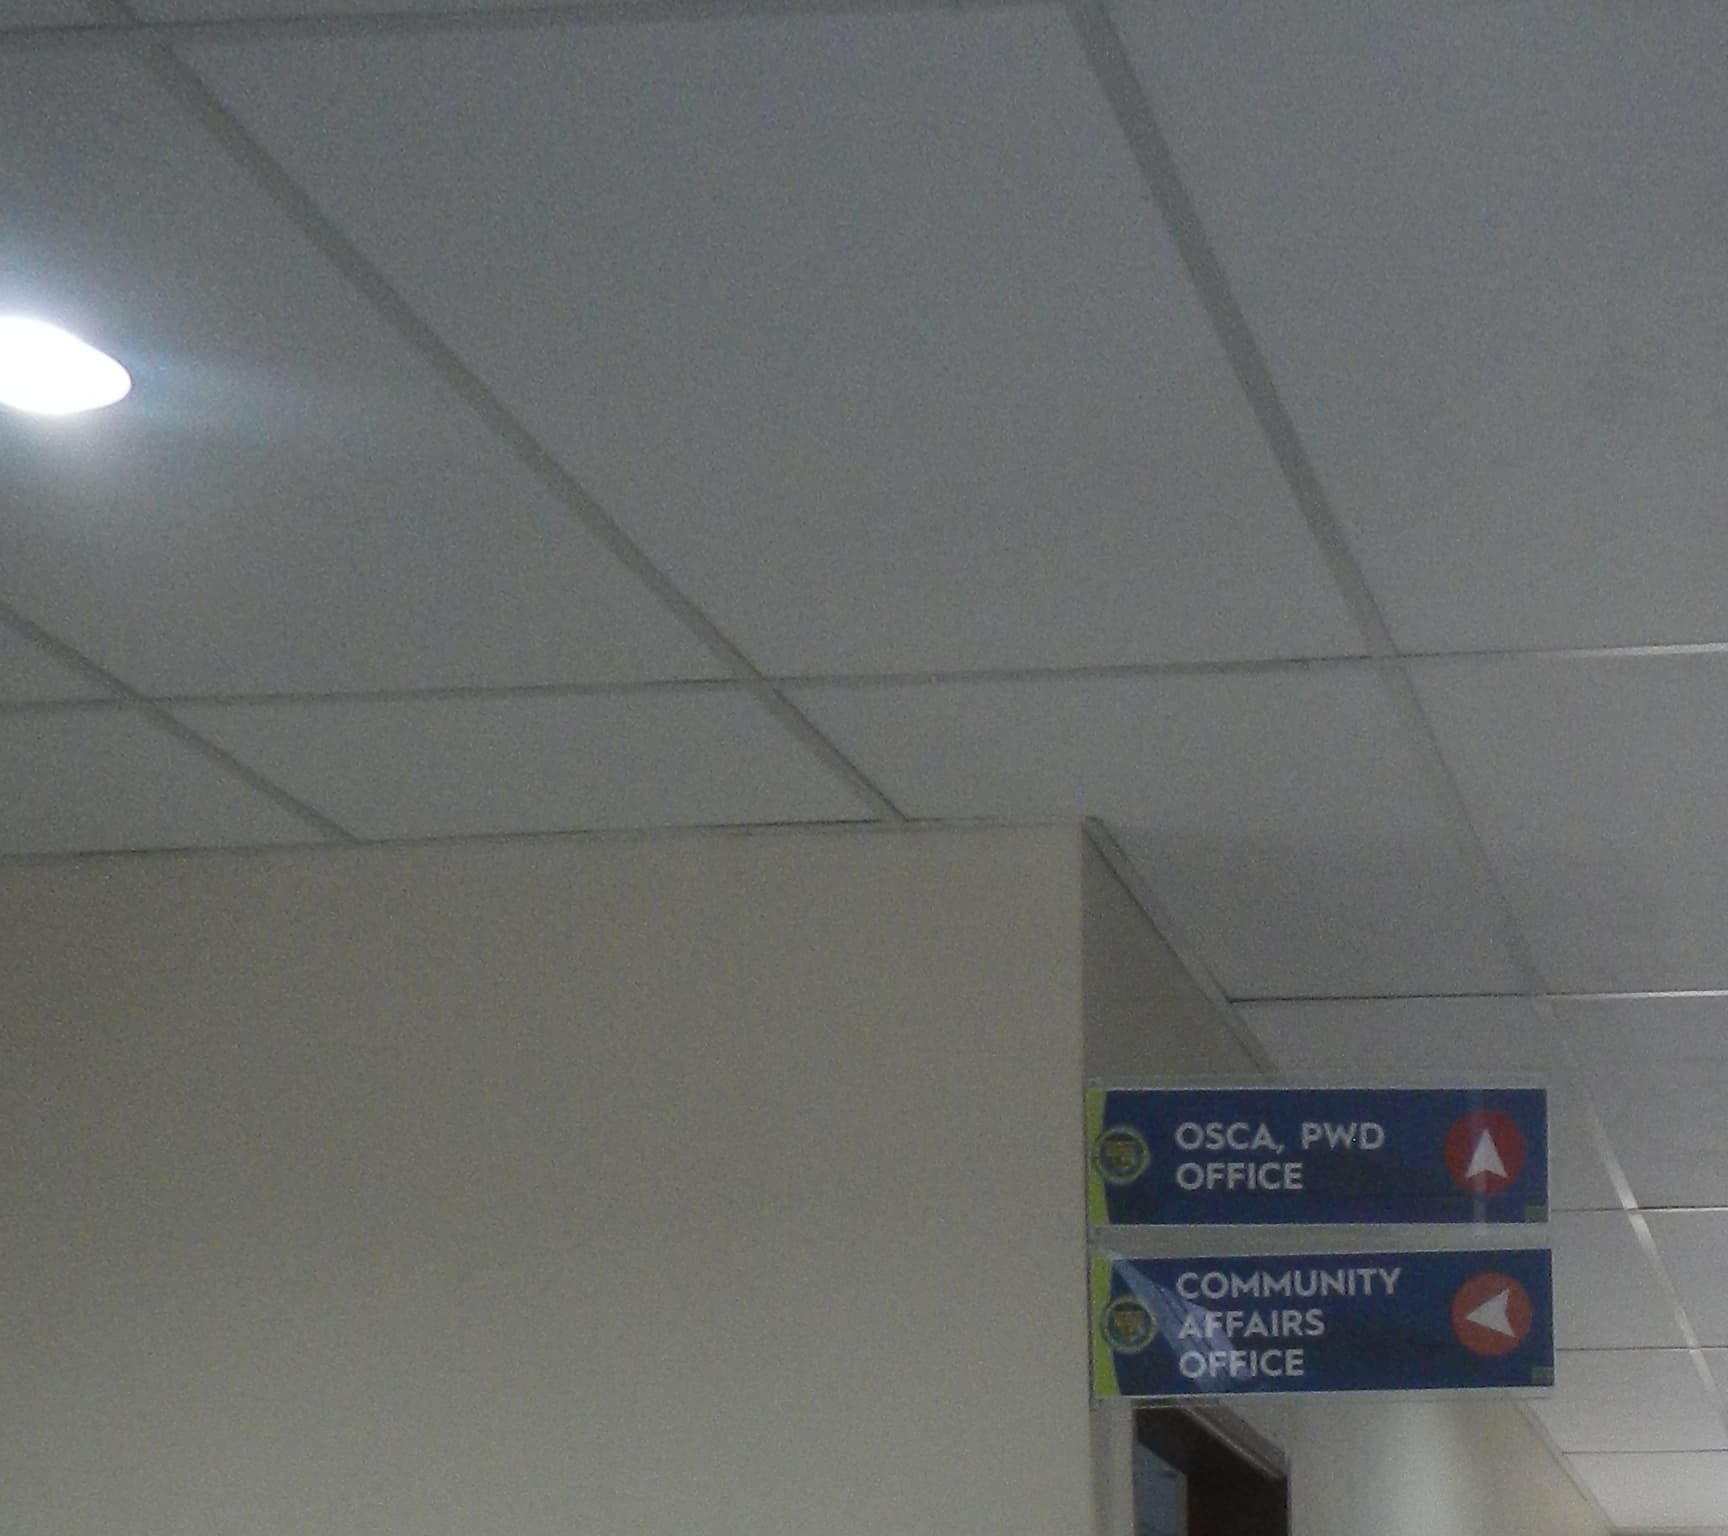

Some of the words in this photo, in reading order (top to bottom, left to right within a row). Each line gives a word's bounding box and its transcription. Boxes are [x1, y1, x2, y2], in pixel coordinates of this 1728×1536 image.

[1175, 1121, 1285, 1154] OSCA,
[1301, 1121, 1385, 1150] PWD
[1176, 1162, 1304, 1190] OFFICE
[1176, 1267, 1401, 1299] COMMUNITY
[1178, 1308, 1325, 1339] AFFAIRS
[1178, 1348, 1305, 1378] OFFICE
